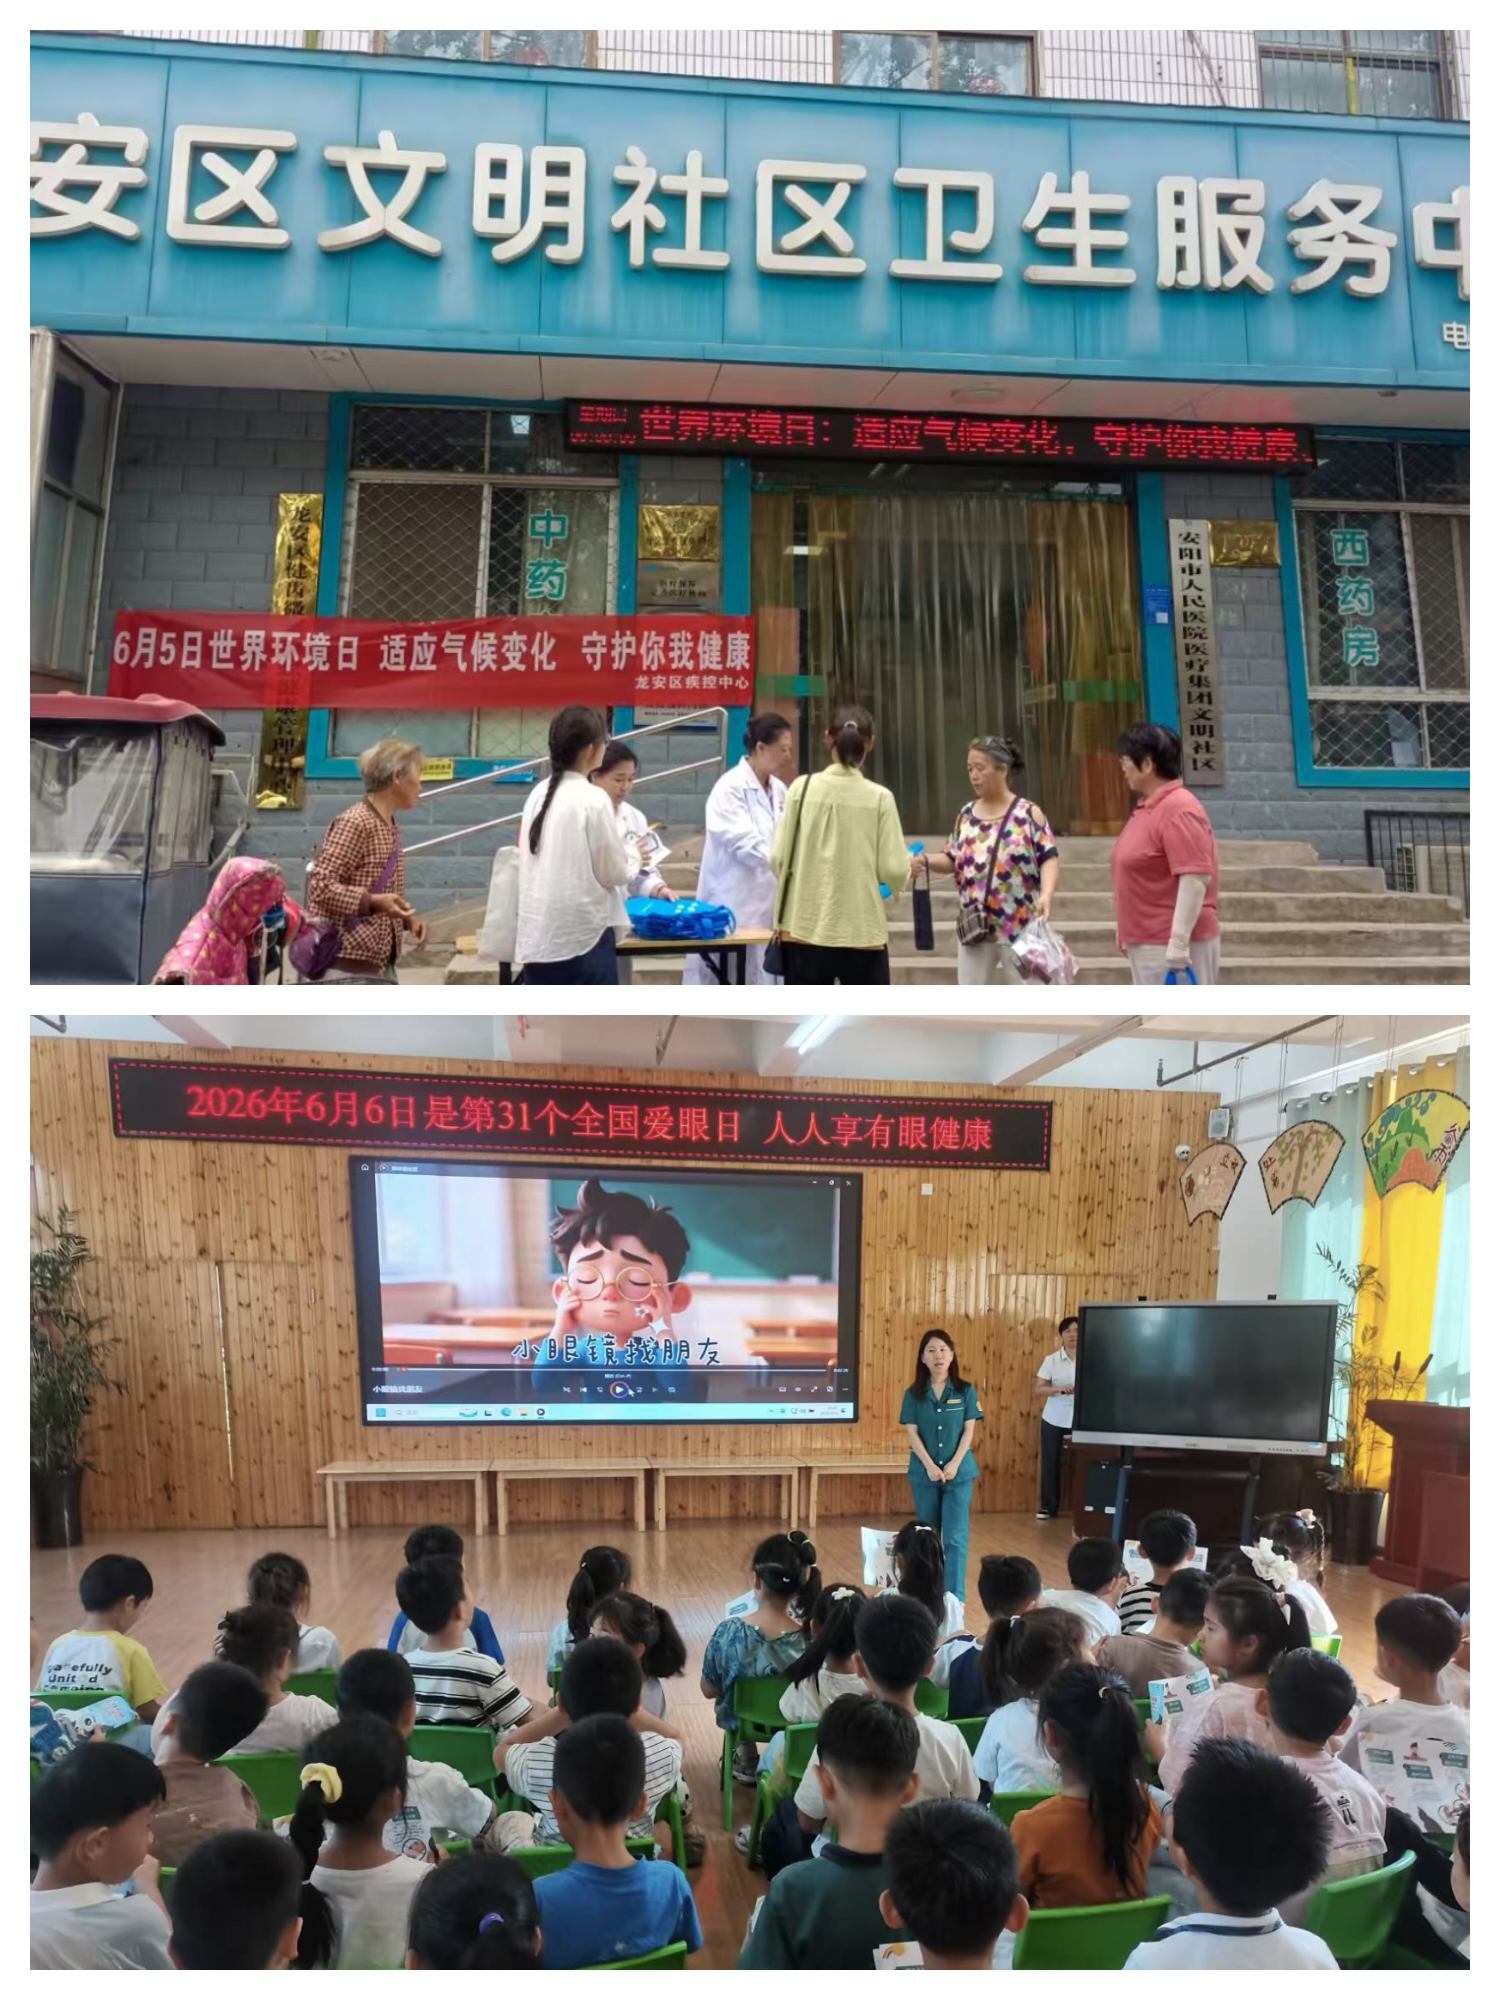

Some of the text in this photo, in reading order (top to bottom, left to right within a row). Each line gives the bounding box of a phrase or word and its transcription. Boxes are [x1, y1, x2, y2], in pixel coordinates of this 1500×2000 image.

[525, 508, 569, 616] 中药
[1330, 529, 1380, 667] 西药房
[113, 627, 751, 672] 6月5日世界环境日 适应气候变化 守护你我健康
[635, 675, 750, 690] 龙安区疾控中心
[1178, 531, 1216, 772] 安阳市人民医院医疗集团文明社区
[186, 1085, 993, 1152] 2026年6月6日是第31个全国爱眼日 人人享有眼健康
[511, 1333, 721, 1366] 小眼镜找朋友
